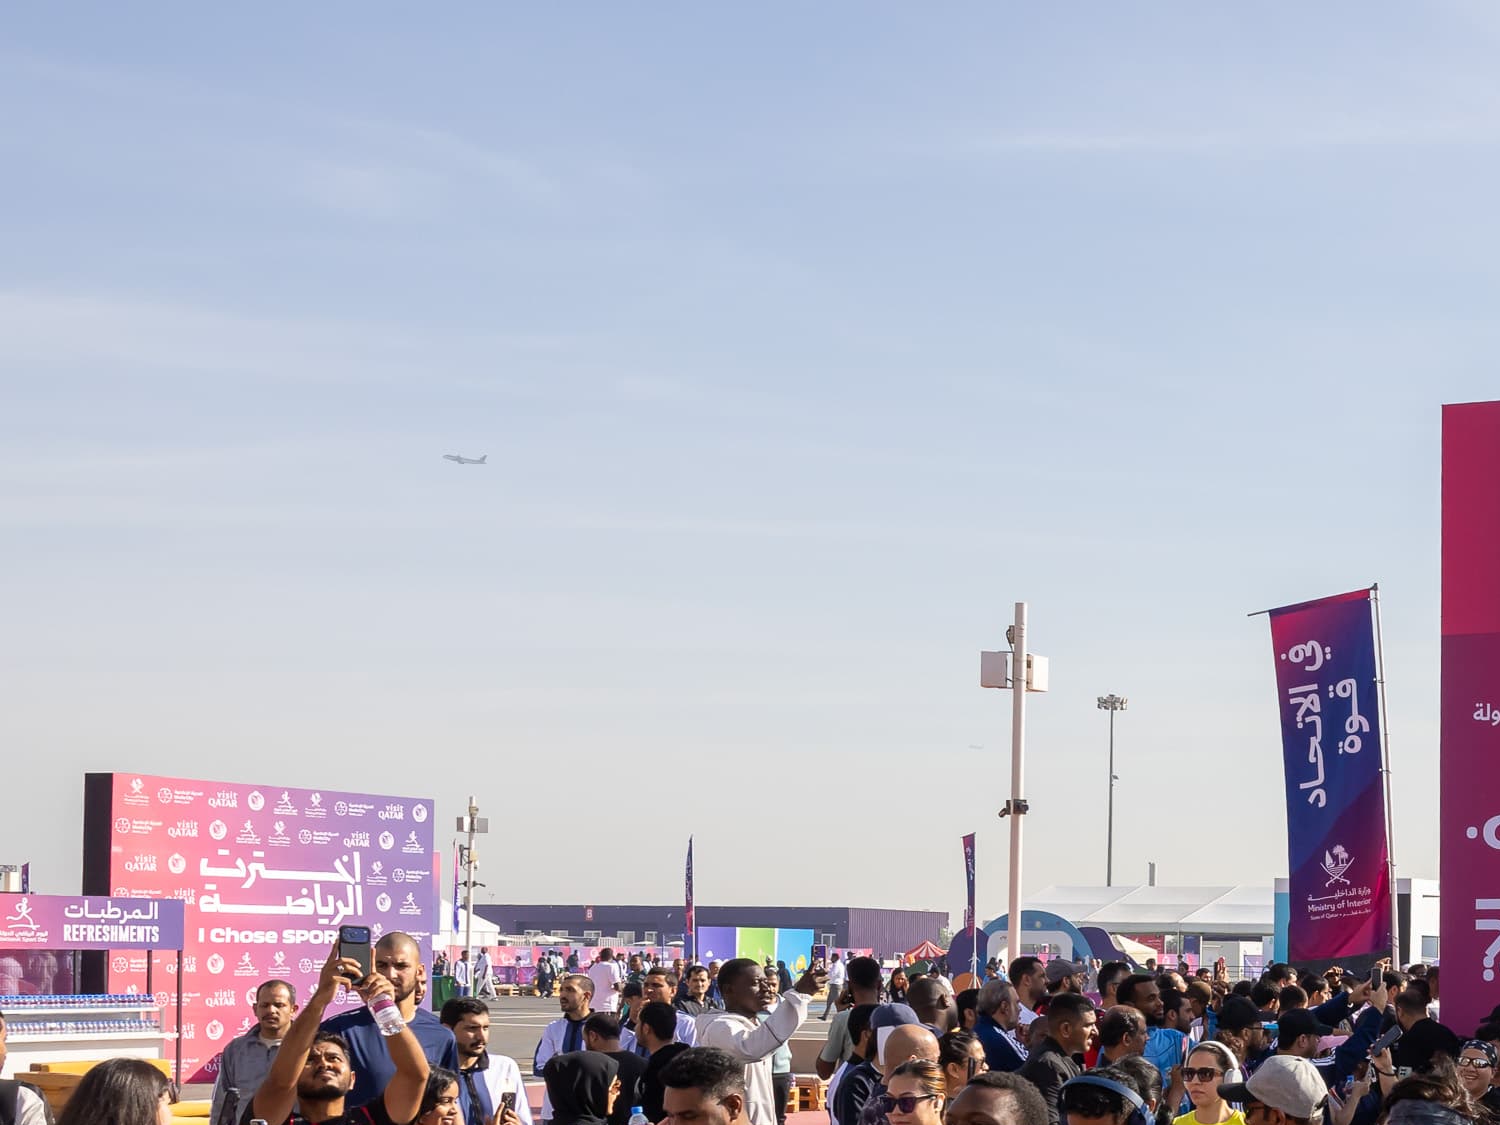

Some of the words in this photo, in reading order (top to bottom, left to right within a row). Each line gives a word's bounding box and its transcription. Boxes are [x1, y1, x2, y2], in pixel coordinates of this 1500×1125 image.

[1280, 640, 1332, 671] في
[1328, 678, 1370, 755] قوة
[208, 798, 238, 808] QATAR
[378, 811, 404, 820] QATAR
[168, 827, 198, 838] QATAR
[343, 838, 370, 848] QATAR
[125, 861, 157, 872] QATAR
[199, 849, 361, 888] اخترت
[64, 900, 159, 924] المرطبات
[199, 884, 363, 925] الرياضة
[1308, 904, 1336, 913] Ministry
[1337, 900, 1345, 908] of
[1346, 898, 1372, 908] Interior
[63, 924, 160, 943] REFRESHMENTS
[198, 928, 205, 943] I
[210, 927, 278, 943] Chose
[282, 929, 341, 944] SPOR
[205, 997, 236, 1007] QATAR
